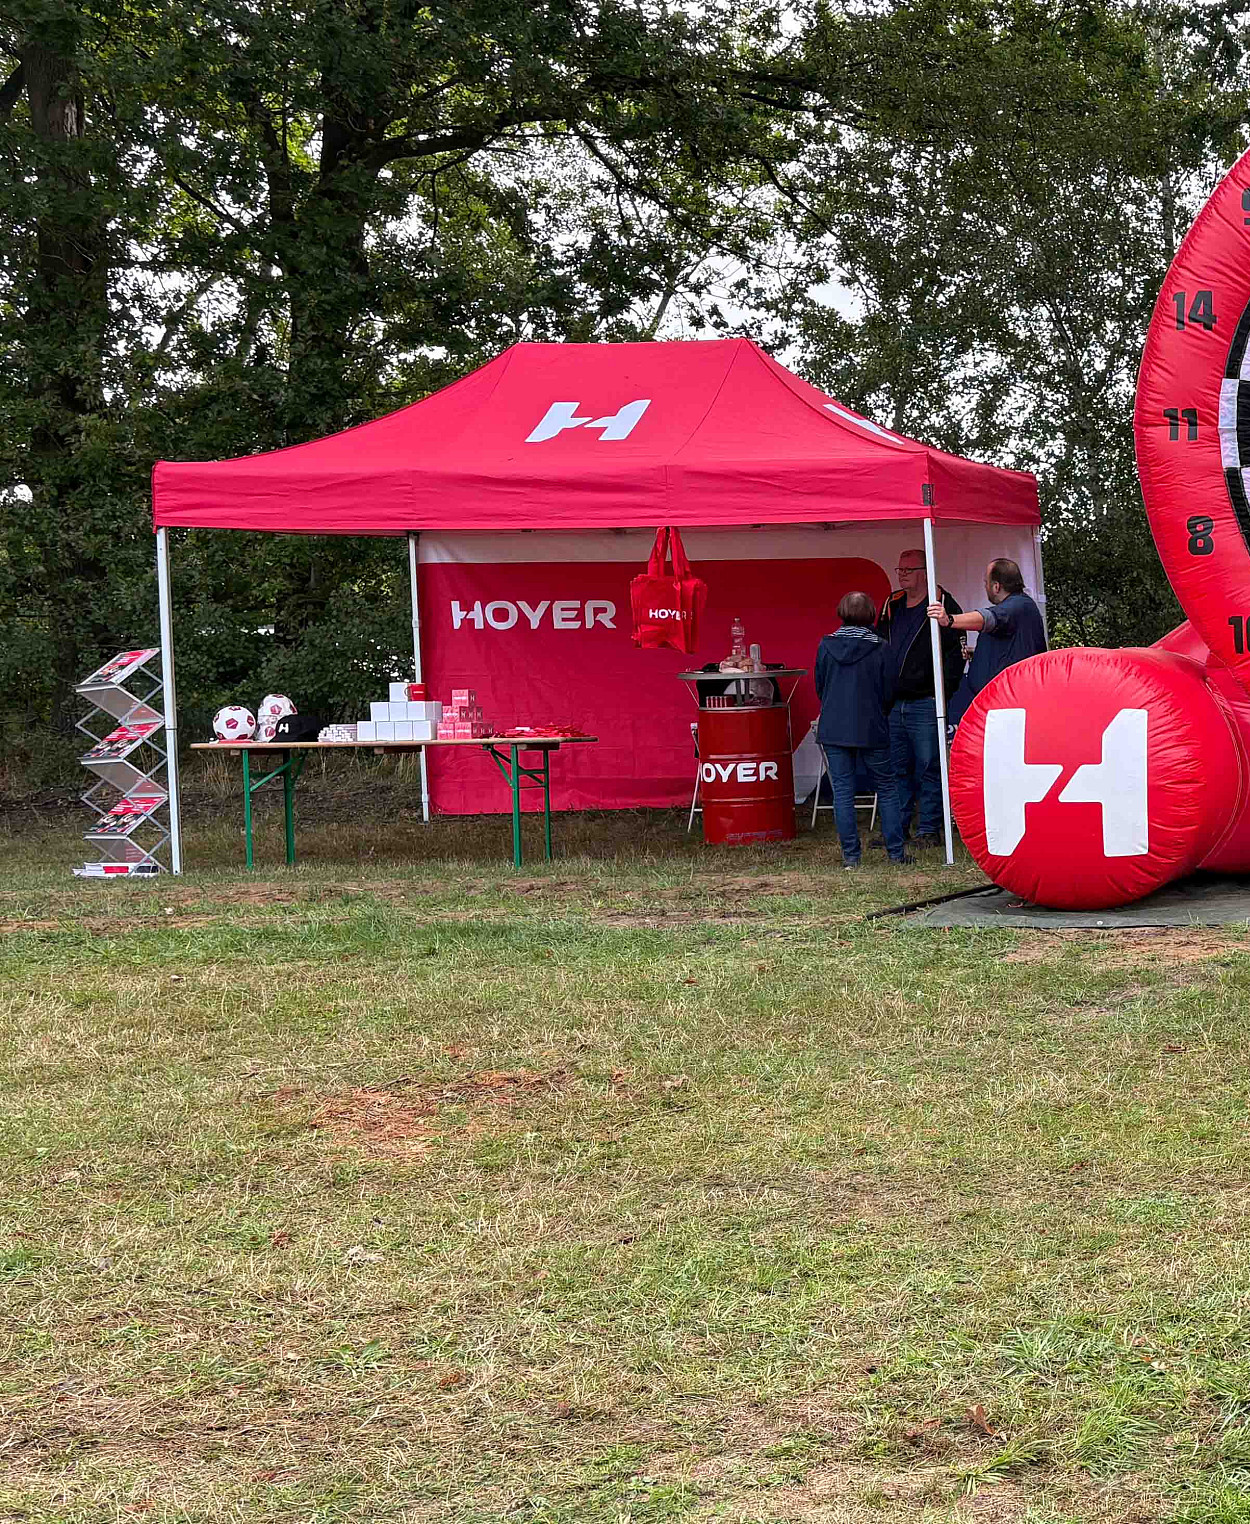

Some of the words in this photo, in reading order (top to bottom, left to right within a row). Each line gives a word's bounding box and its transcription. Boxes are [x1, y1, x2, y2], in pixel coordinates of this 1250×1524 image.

[1173, 291, 1216, 331] 14
[525, 400, 651, 442] H
[1164, 408, 1198, 440] 11
[1187, 516, 1213, 555] 8
[451, 601, 616, 629] HOYER
[700, 761, 778, 783] OYER
[984, 708, 1148, 857] H
